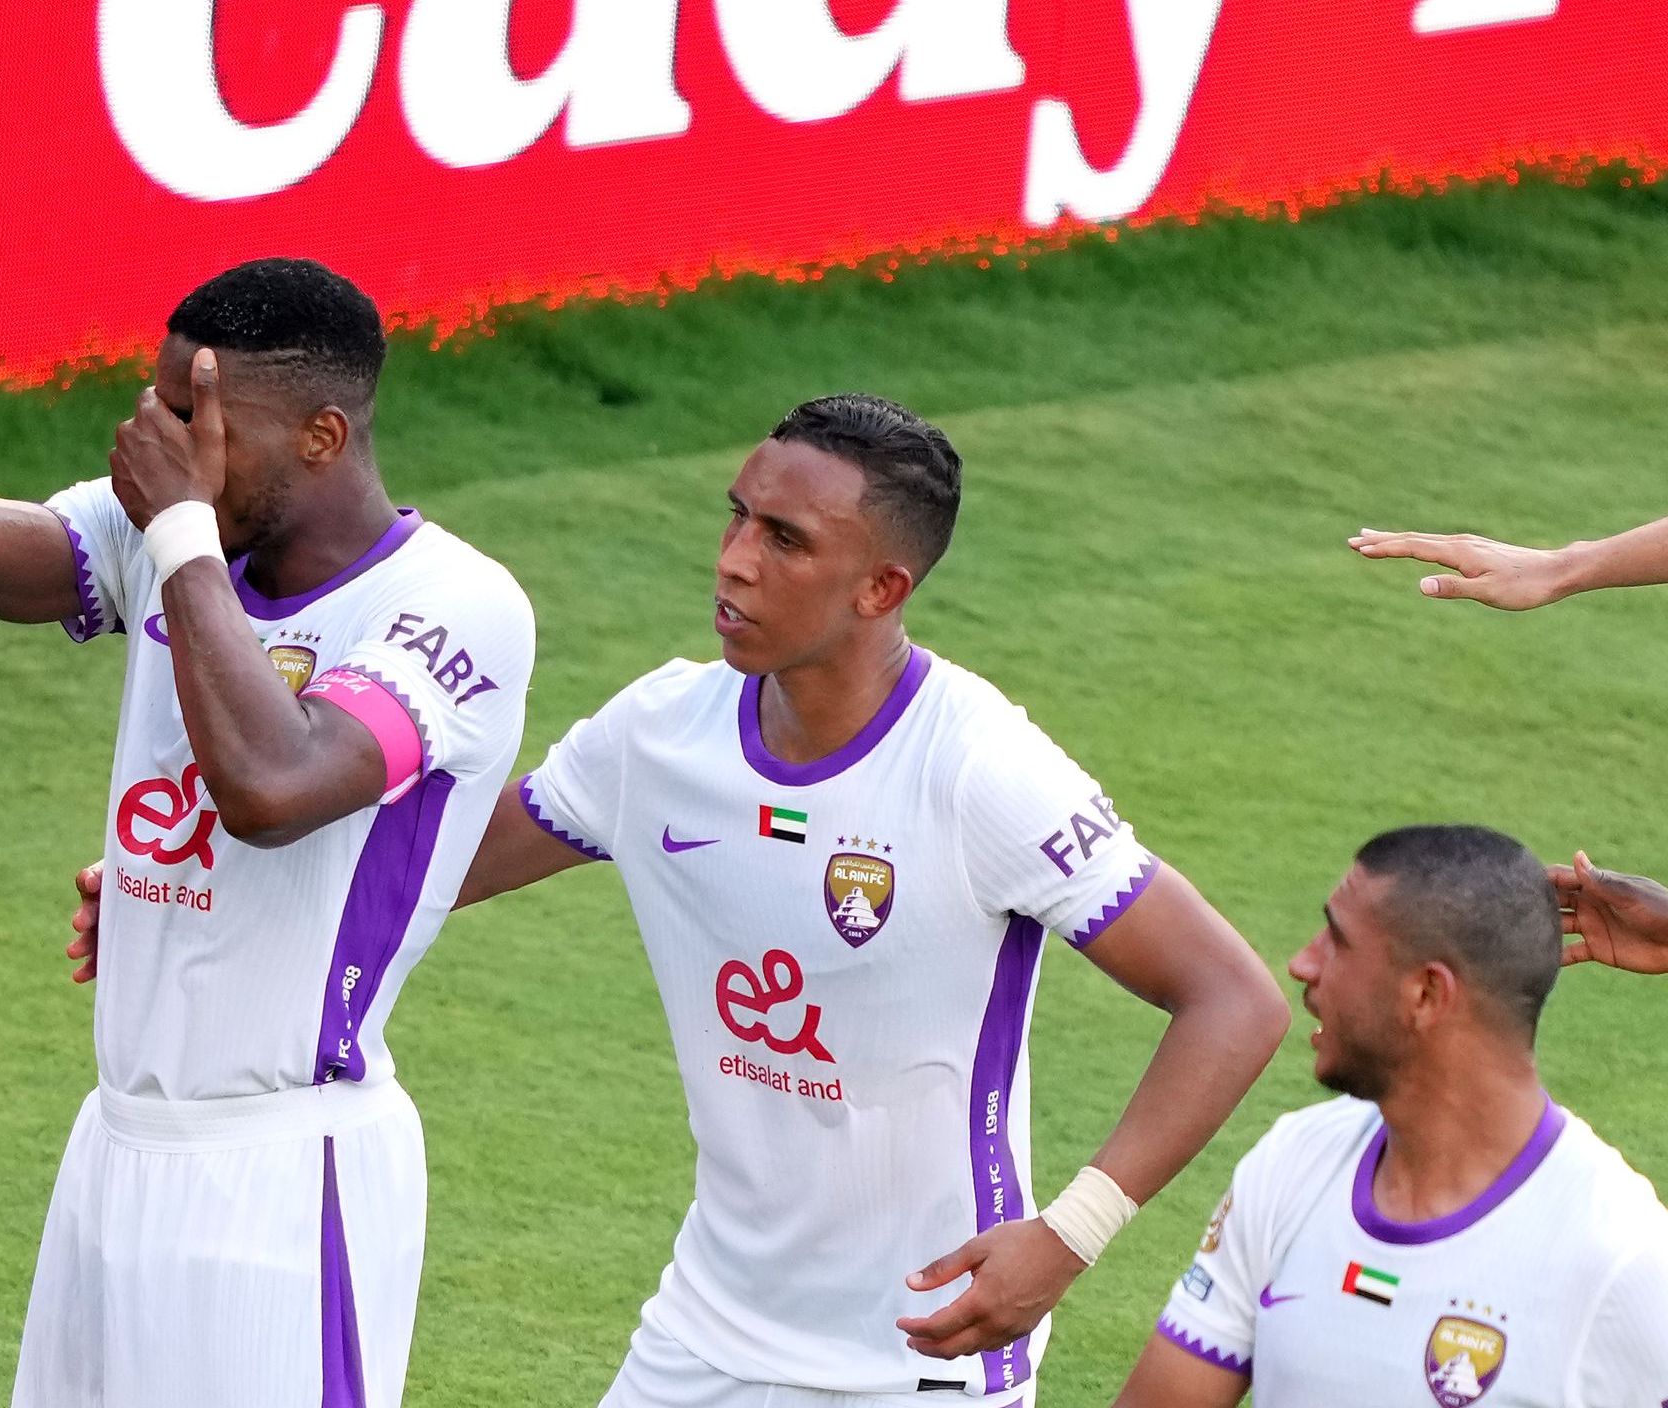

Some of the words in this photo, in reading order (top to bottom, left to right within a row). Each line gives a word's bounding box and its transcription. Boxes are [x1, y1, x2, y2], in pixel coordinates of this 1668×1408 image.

[117, 866, 172, 904] tisalat
[176, 885, 213, 913] and
[833, 867, 849, 880] AL
[848, 869, 870, 884] AIN
[868, 873, 886, 886] FC
[338, 1038, 352, 1060] FC
[719, 1055, 792, 1093] etisalat
[797, 1079, 843, 1101] and
[985, 1089, 1000, 1136] 1968
[988, 1163, 1002, 1185] FC
[993, 1187, 1005, 1214] AIN
